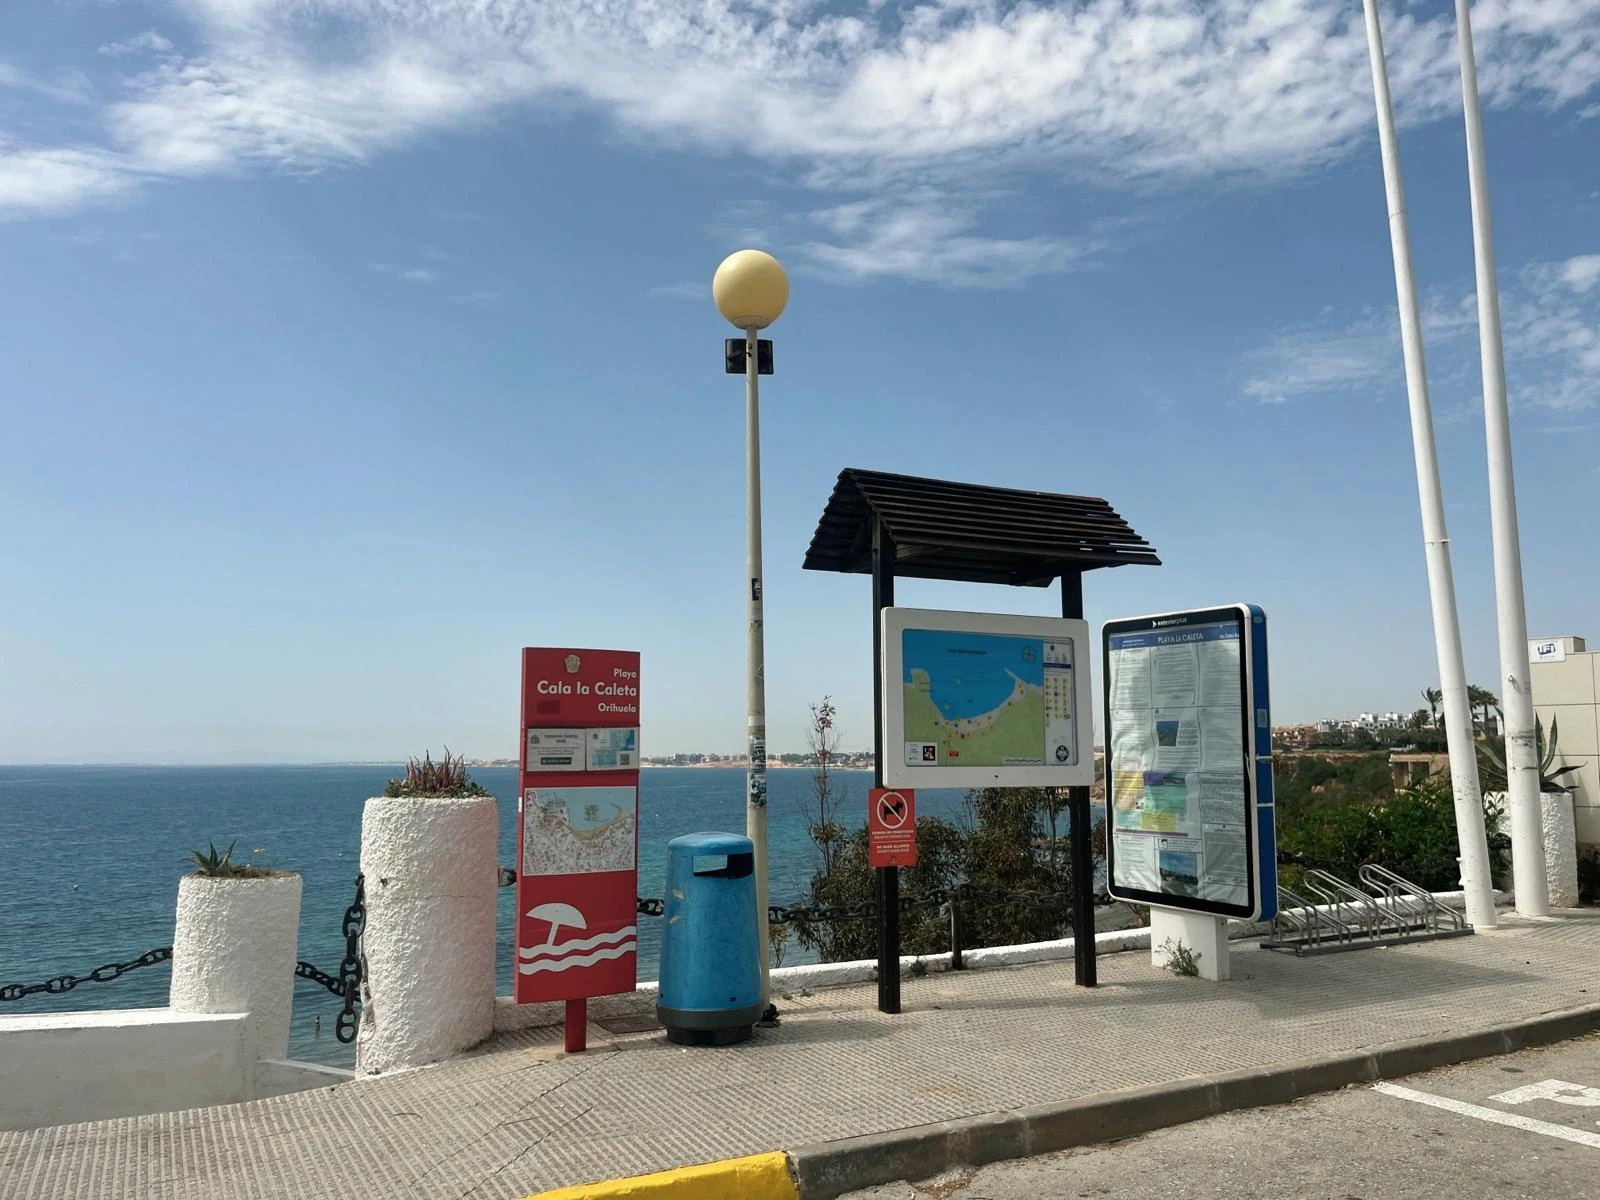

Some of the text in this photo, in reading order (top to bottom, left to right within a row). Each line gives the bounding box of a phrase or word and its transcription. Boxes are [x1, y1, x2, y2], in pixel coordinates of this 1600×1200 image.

[1157, 632, 1204, 644] PLAYA LA CALETA
[613, 668, 637, 679] Playa
[537, 680, 637, 696] Cala la Caleta
[597, 702, 637, 713] Orihuela
